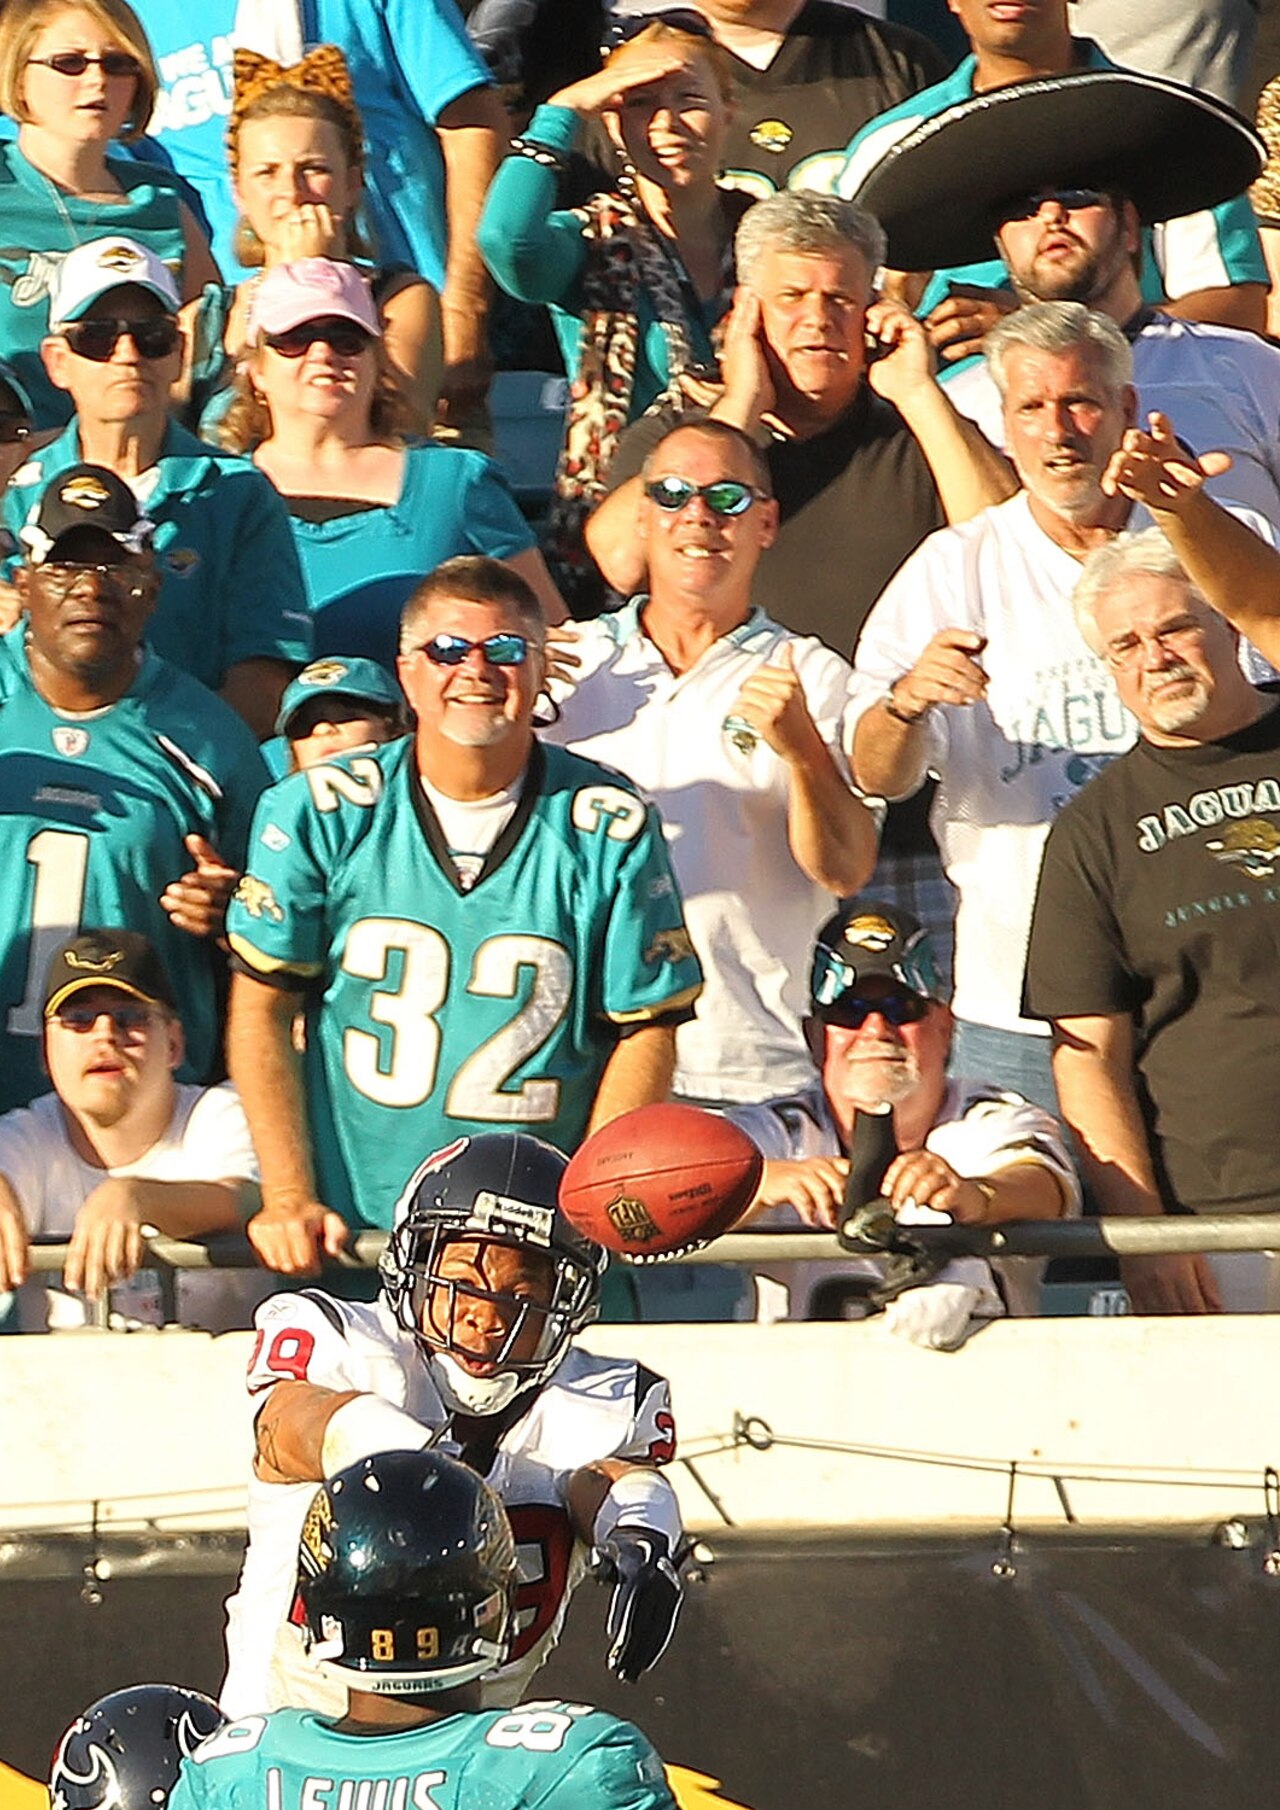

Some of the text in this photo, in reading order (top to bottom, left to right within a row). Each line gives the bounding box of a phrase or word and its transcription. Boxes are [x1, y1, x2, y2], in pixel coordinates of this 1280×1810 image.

[6, 828, 90, 1037] 1
[340, 916, 575, 1123] 32
[247, 1327, 316, 1381] 9
[372, 1679, 465, 1692] JAGUARS
[483, 1699, 597, 1754] 8
